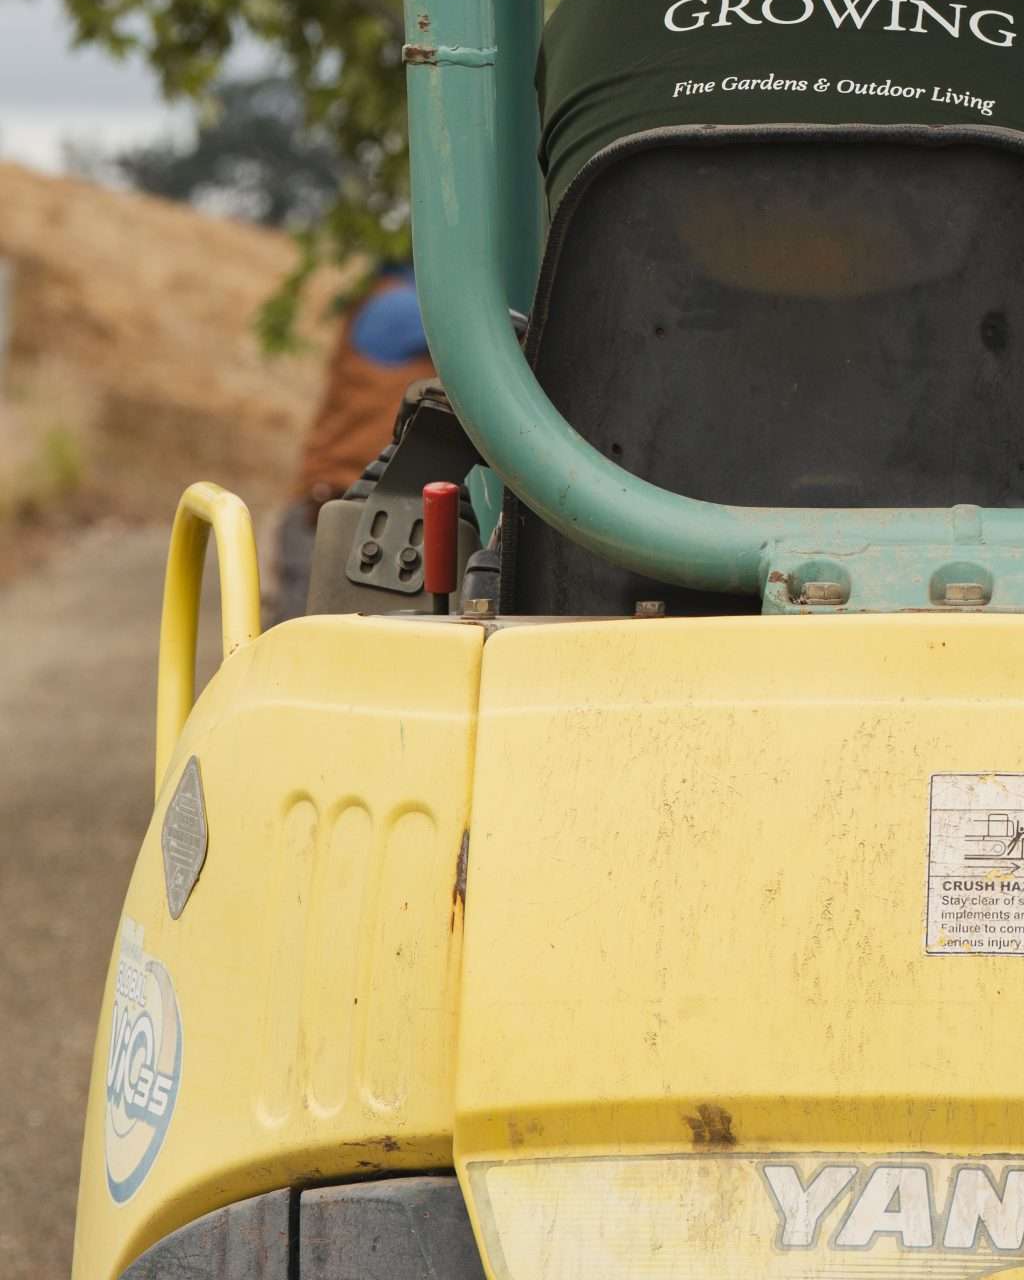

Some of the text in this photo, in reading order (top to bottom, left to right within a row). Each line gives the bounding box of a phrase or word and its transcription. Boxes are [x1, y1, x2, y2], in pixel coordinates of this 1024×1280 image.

[672, 73, 996, 116] Fine Gardens & Outdoor Living
[942, 880, 995, 892] CRUSH
[941, 895, 967, 908] Stay
[971, 895, 1000, 906] clear
[1003, 896, 1015, 906] of
[984, 923, 996, 934] to
[941, 936, 984, 948] erious
